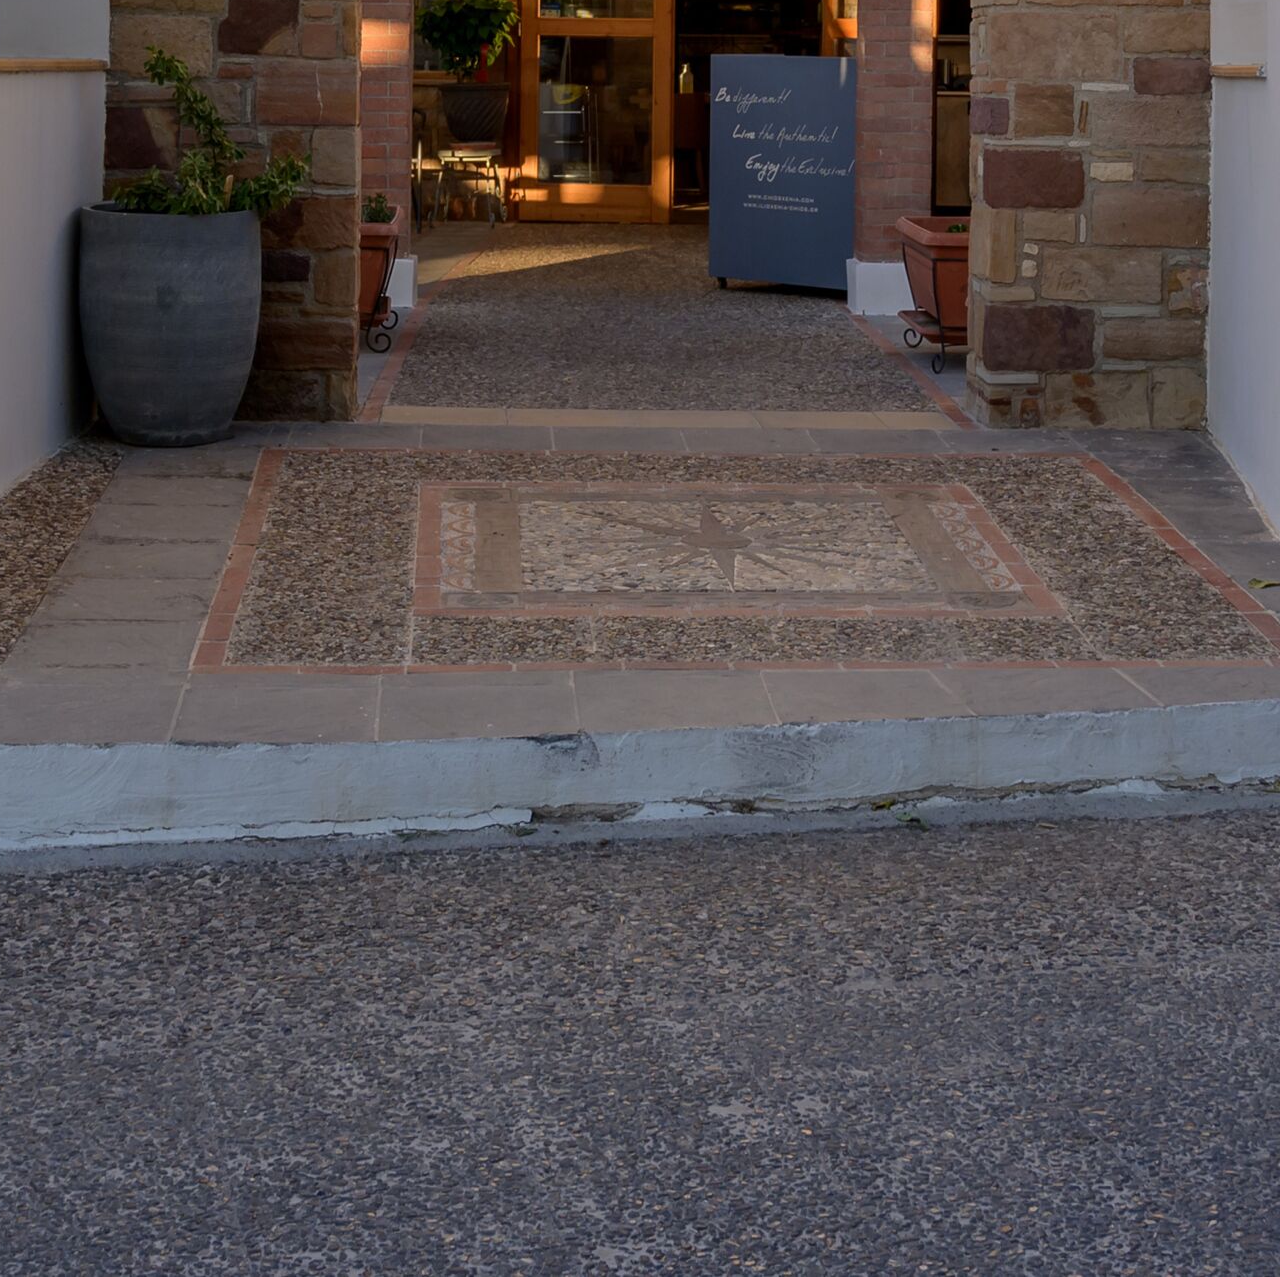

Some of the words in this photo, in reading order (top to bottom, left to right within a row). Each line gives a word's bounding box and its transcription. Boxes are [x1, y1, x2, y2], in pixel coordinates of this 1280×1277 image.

[715, 87, 730, 102] Be
[758, 123, 775, 140] the
[745, 154, 780, 182] Enjoy
[780, 156, 797, 174] the
